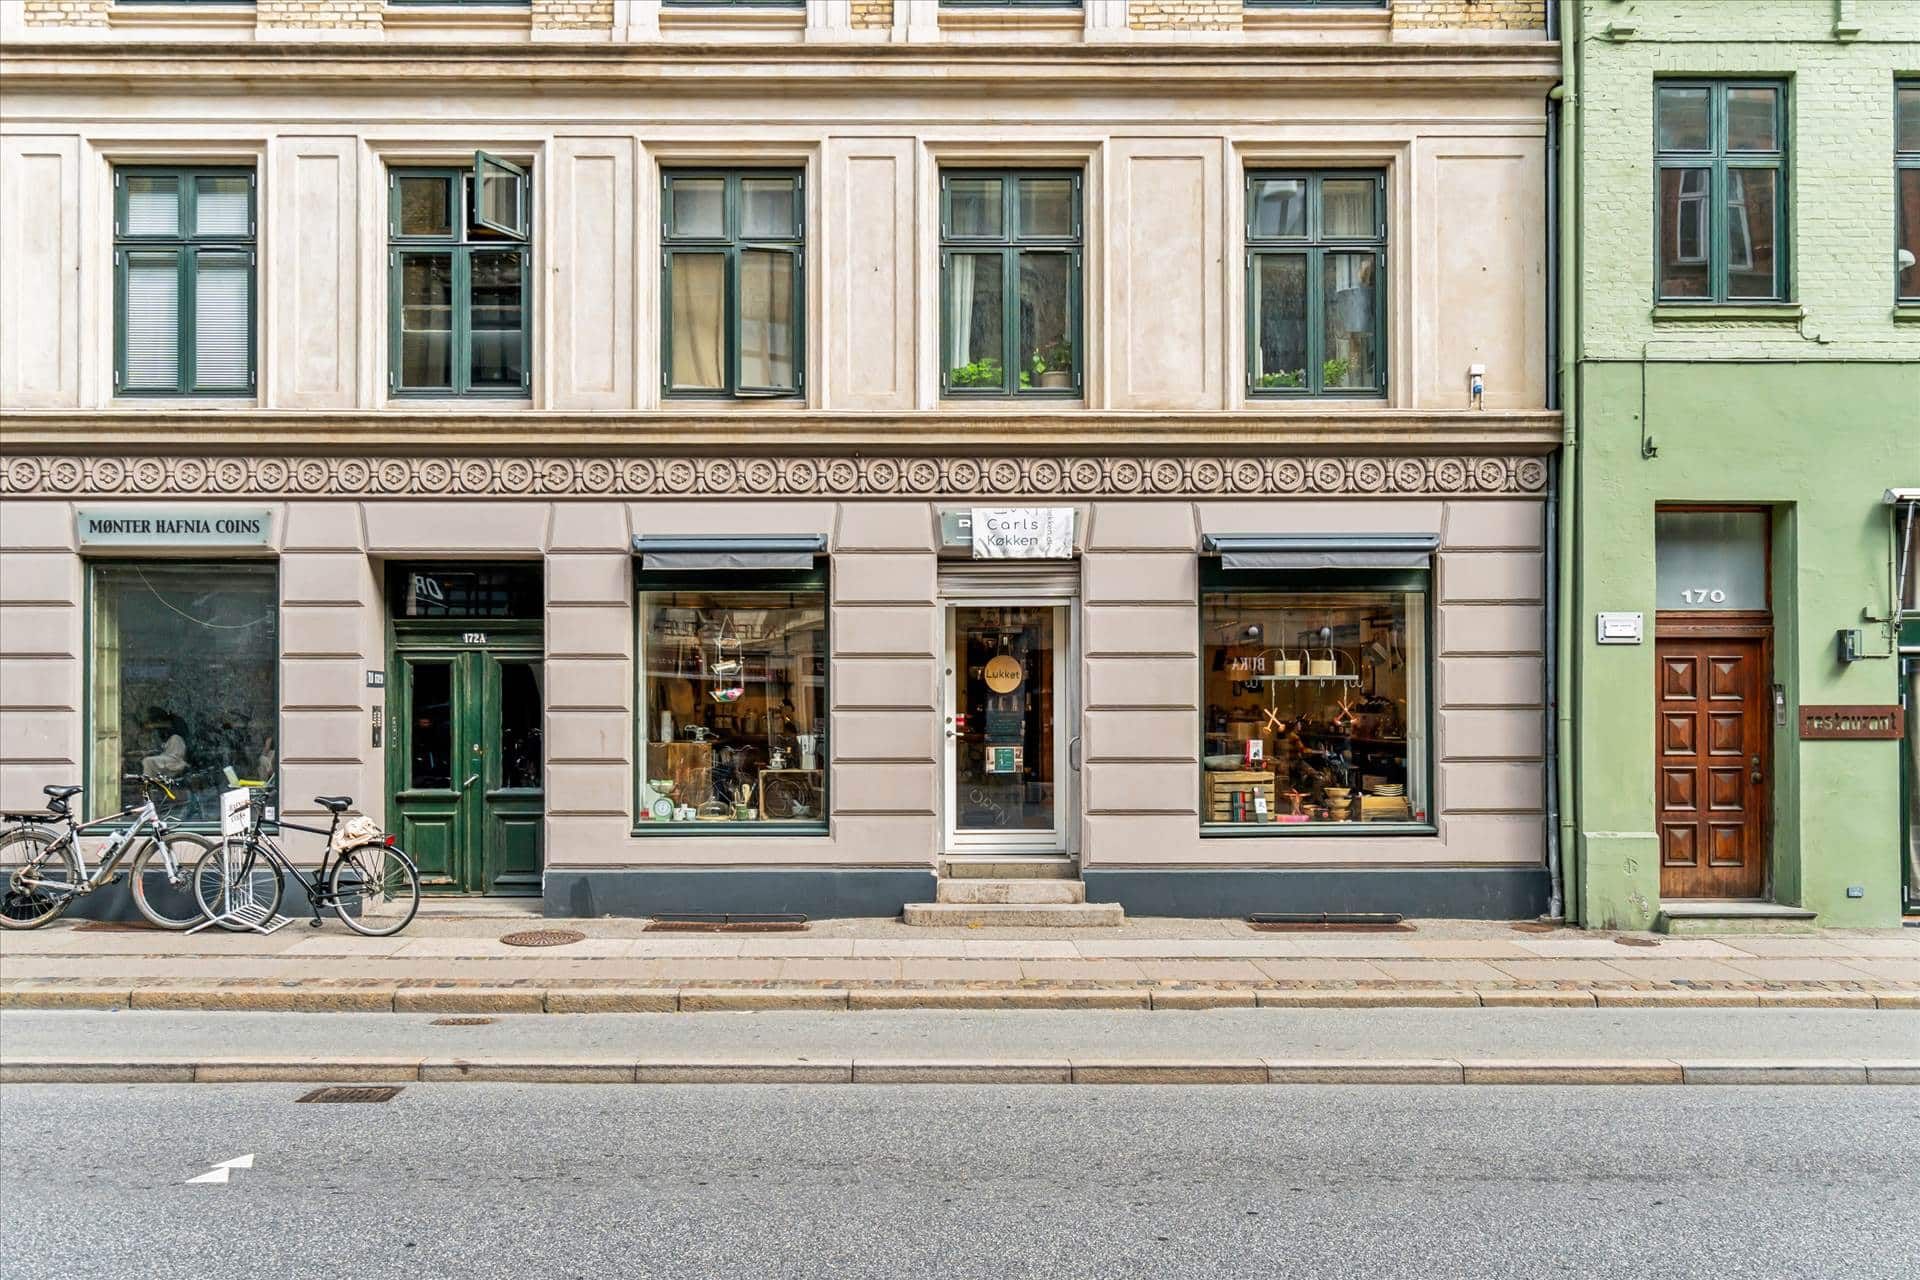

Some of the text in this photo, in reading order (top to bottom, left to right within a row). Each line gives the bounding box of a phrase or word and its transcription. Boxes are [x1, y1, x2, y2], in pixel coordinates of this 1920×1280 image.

[89, 519, 260, 534] MØNTER HAFNIA COINS
[986, 518, 1039, 531] Carls
[986, 534, 1039, 546] Køkken
[1681, 589, 1726, 603] 170
[463, 633, 486, 643] 172A
[986, 668, 1021, 680] Lukket
[1806, 711, 1897, 731] restaurant
